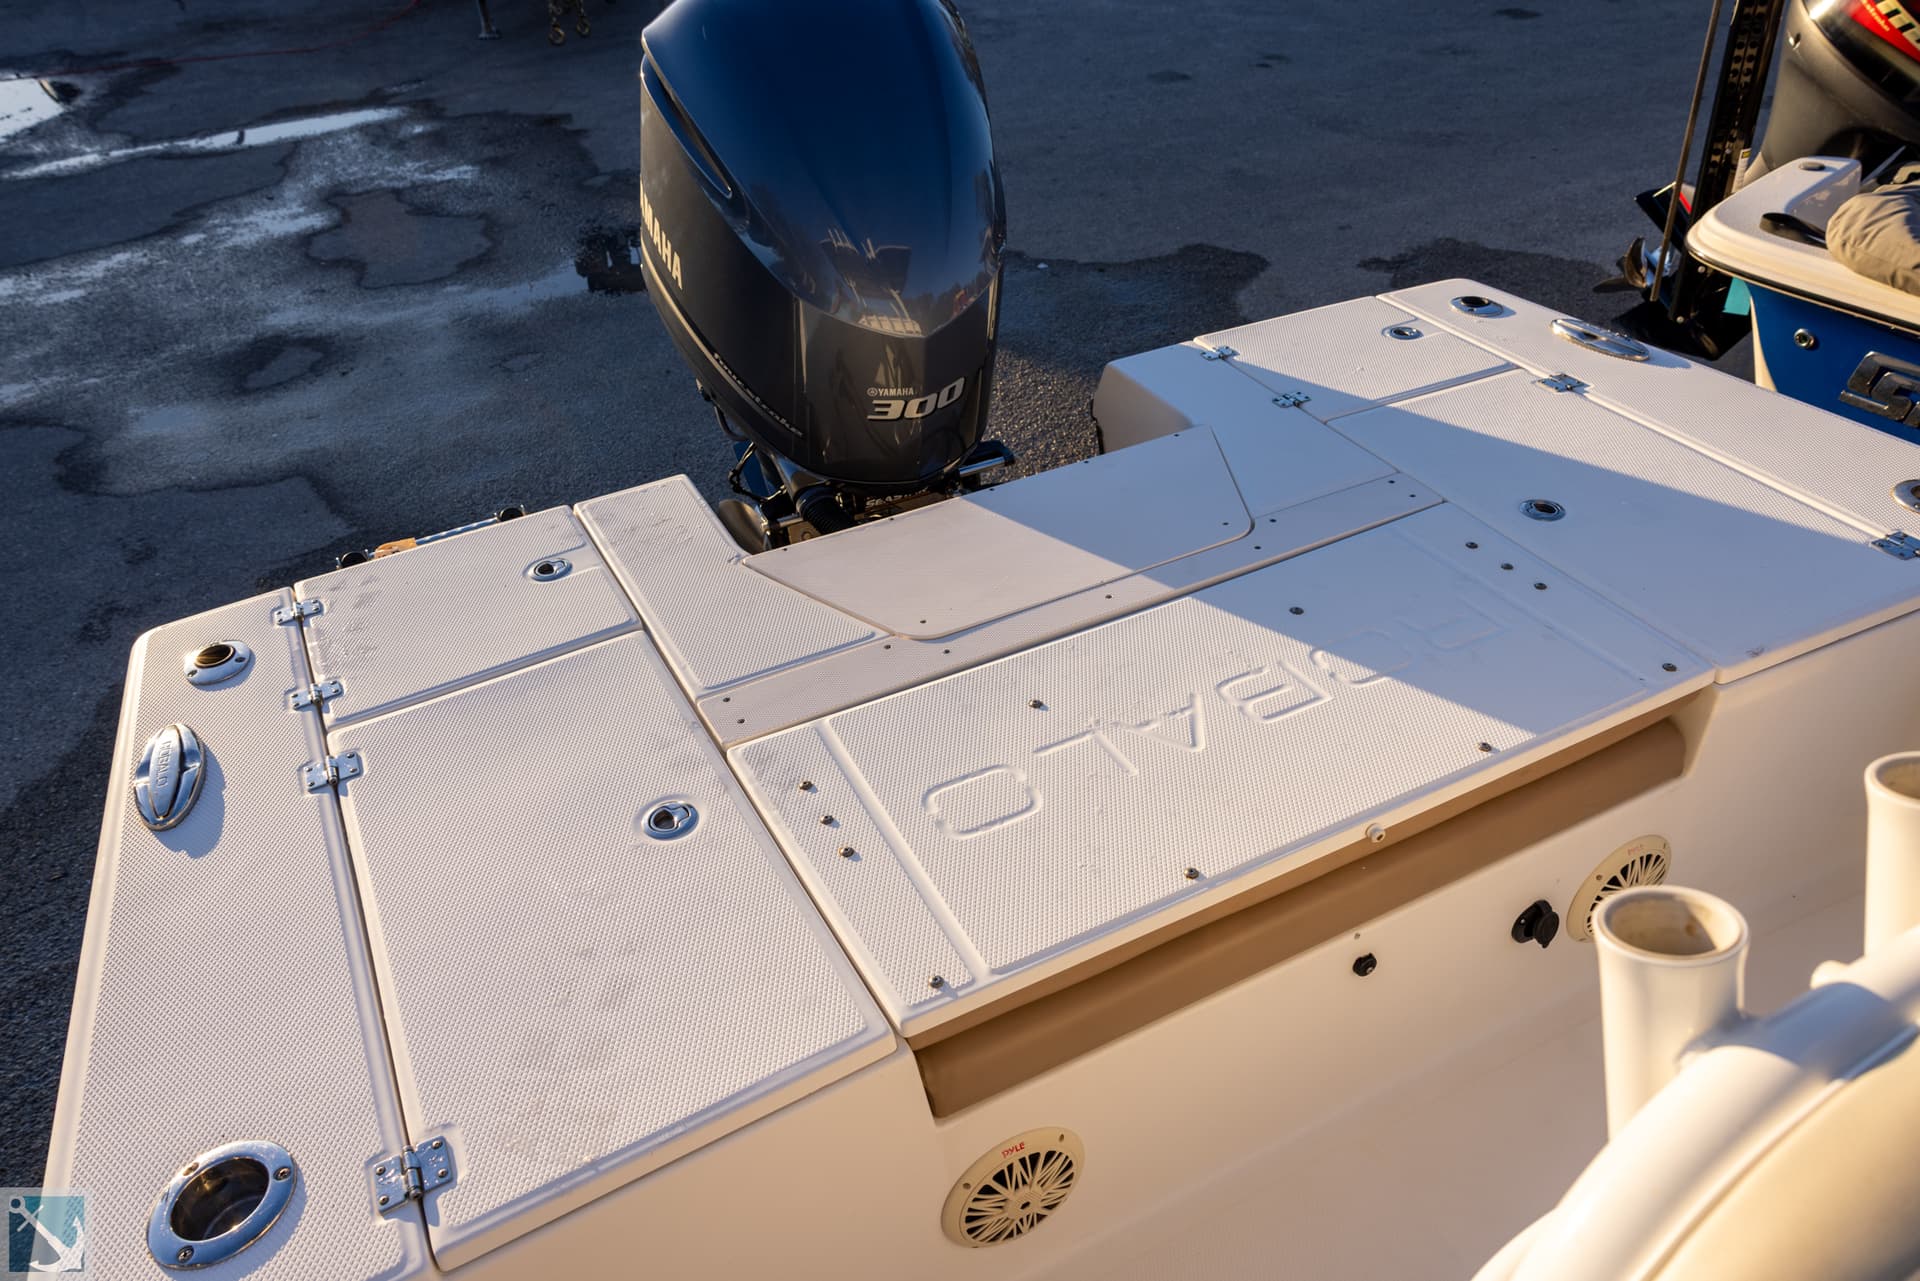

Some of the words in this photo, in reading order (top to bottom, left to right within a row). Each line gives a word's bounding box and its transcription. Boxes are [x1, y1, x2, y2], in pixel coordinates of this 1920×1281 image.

[867, 377, 965, 420] 300
[878, 387, 914, 397] YAMAHA
[1001, 1141, 1025, 1158] PYLE
